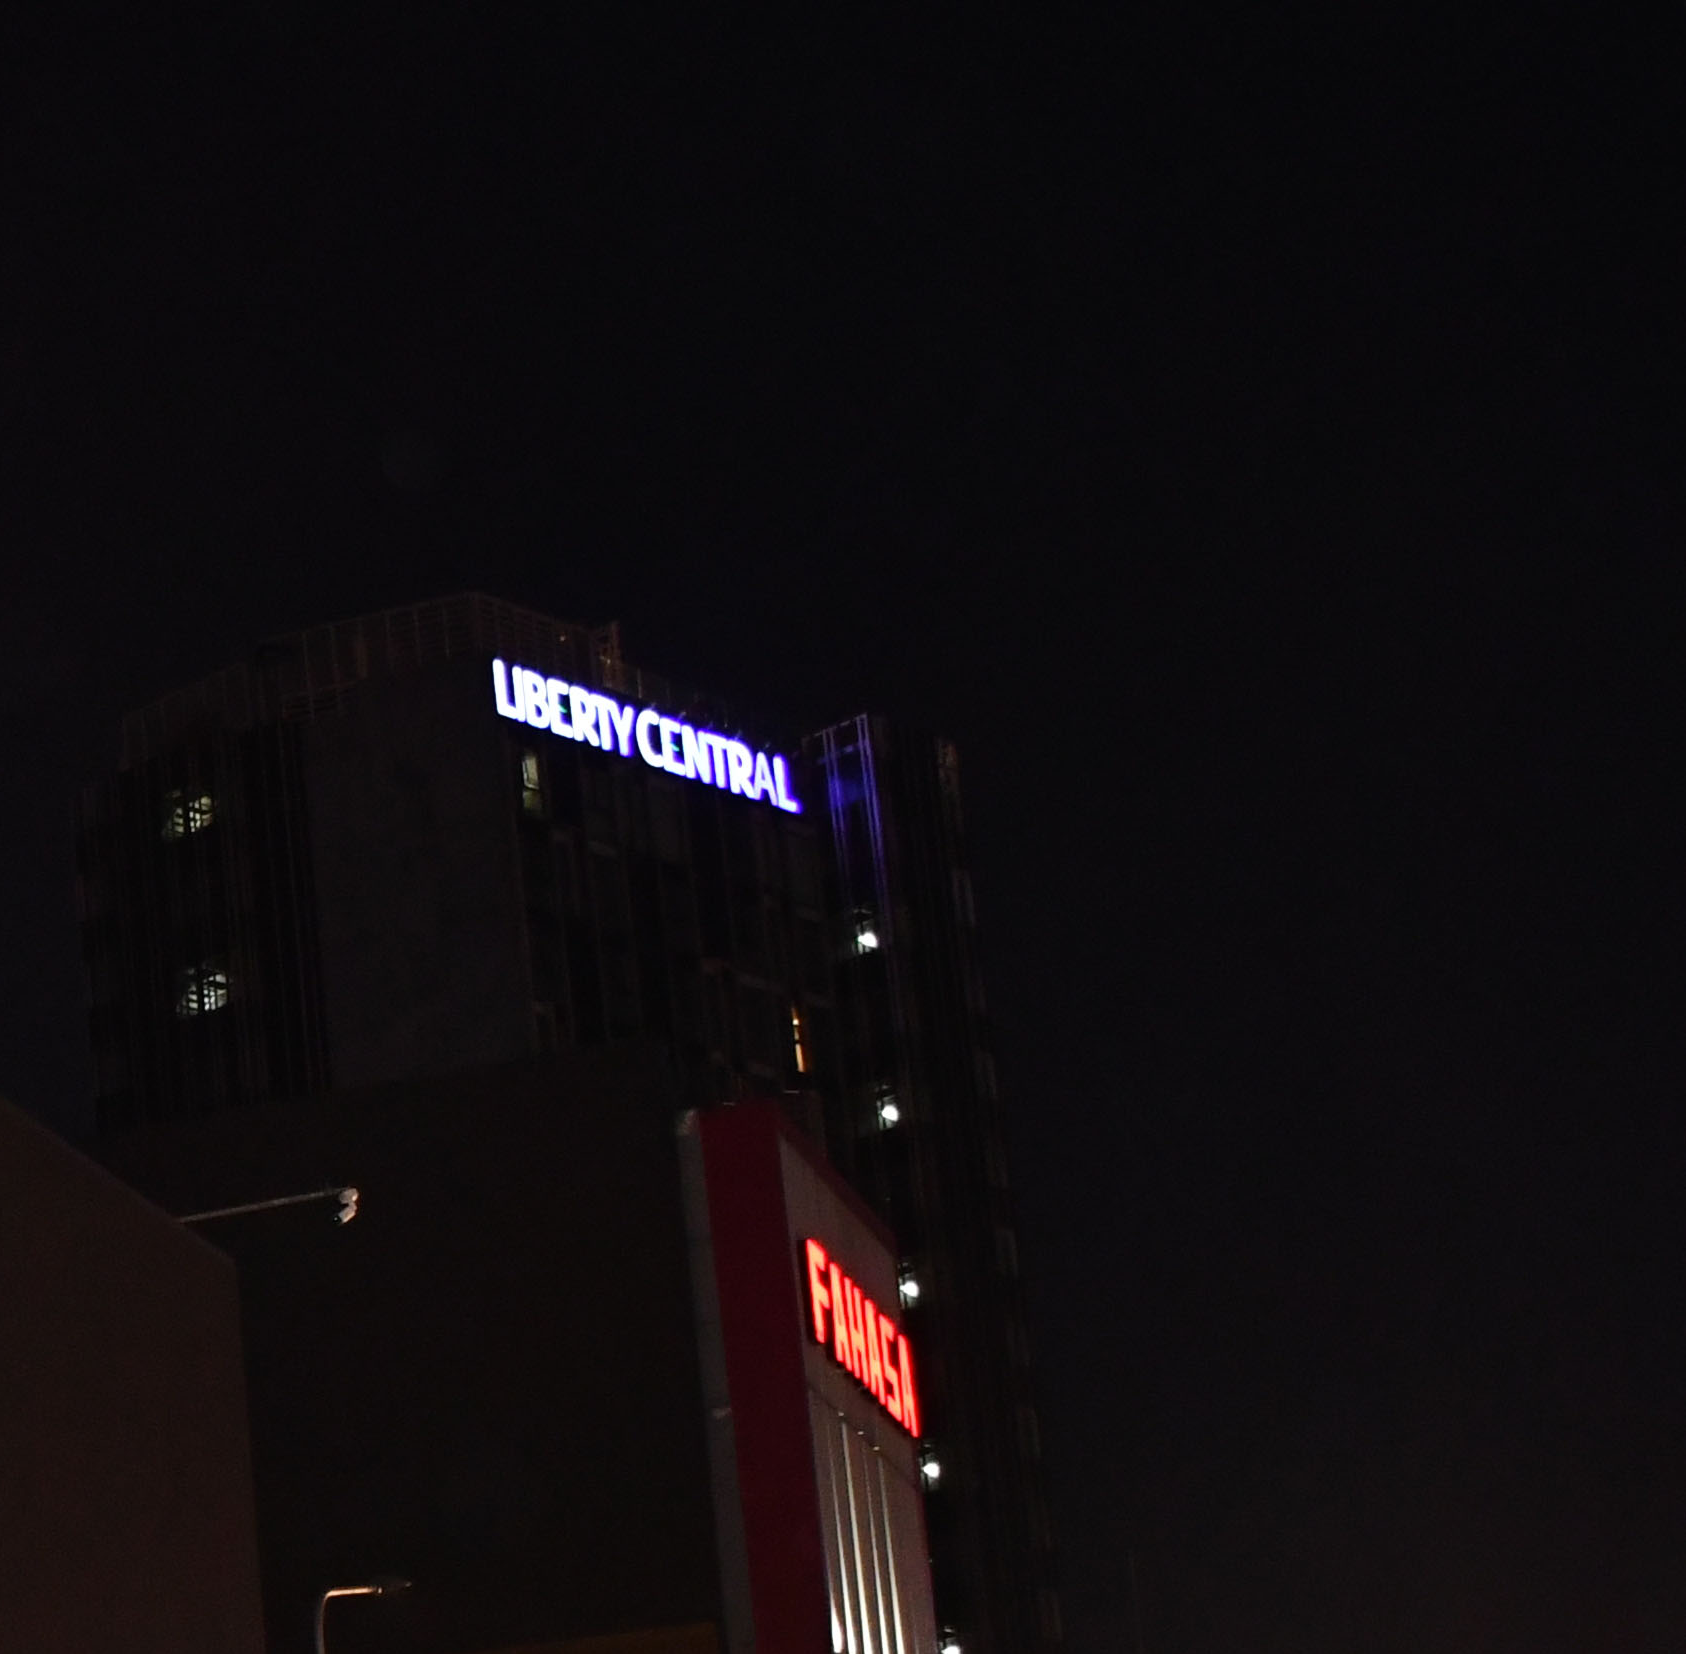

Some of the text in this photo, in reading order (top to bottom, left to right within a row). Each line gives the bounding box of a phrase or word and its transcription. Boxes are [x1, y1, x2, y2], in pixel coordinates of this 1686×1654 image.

[492, 657, 803, 813] LIBERTY CENTRAL
[805, 1237, 921, 1438] FAHASA
